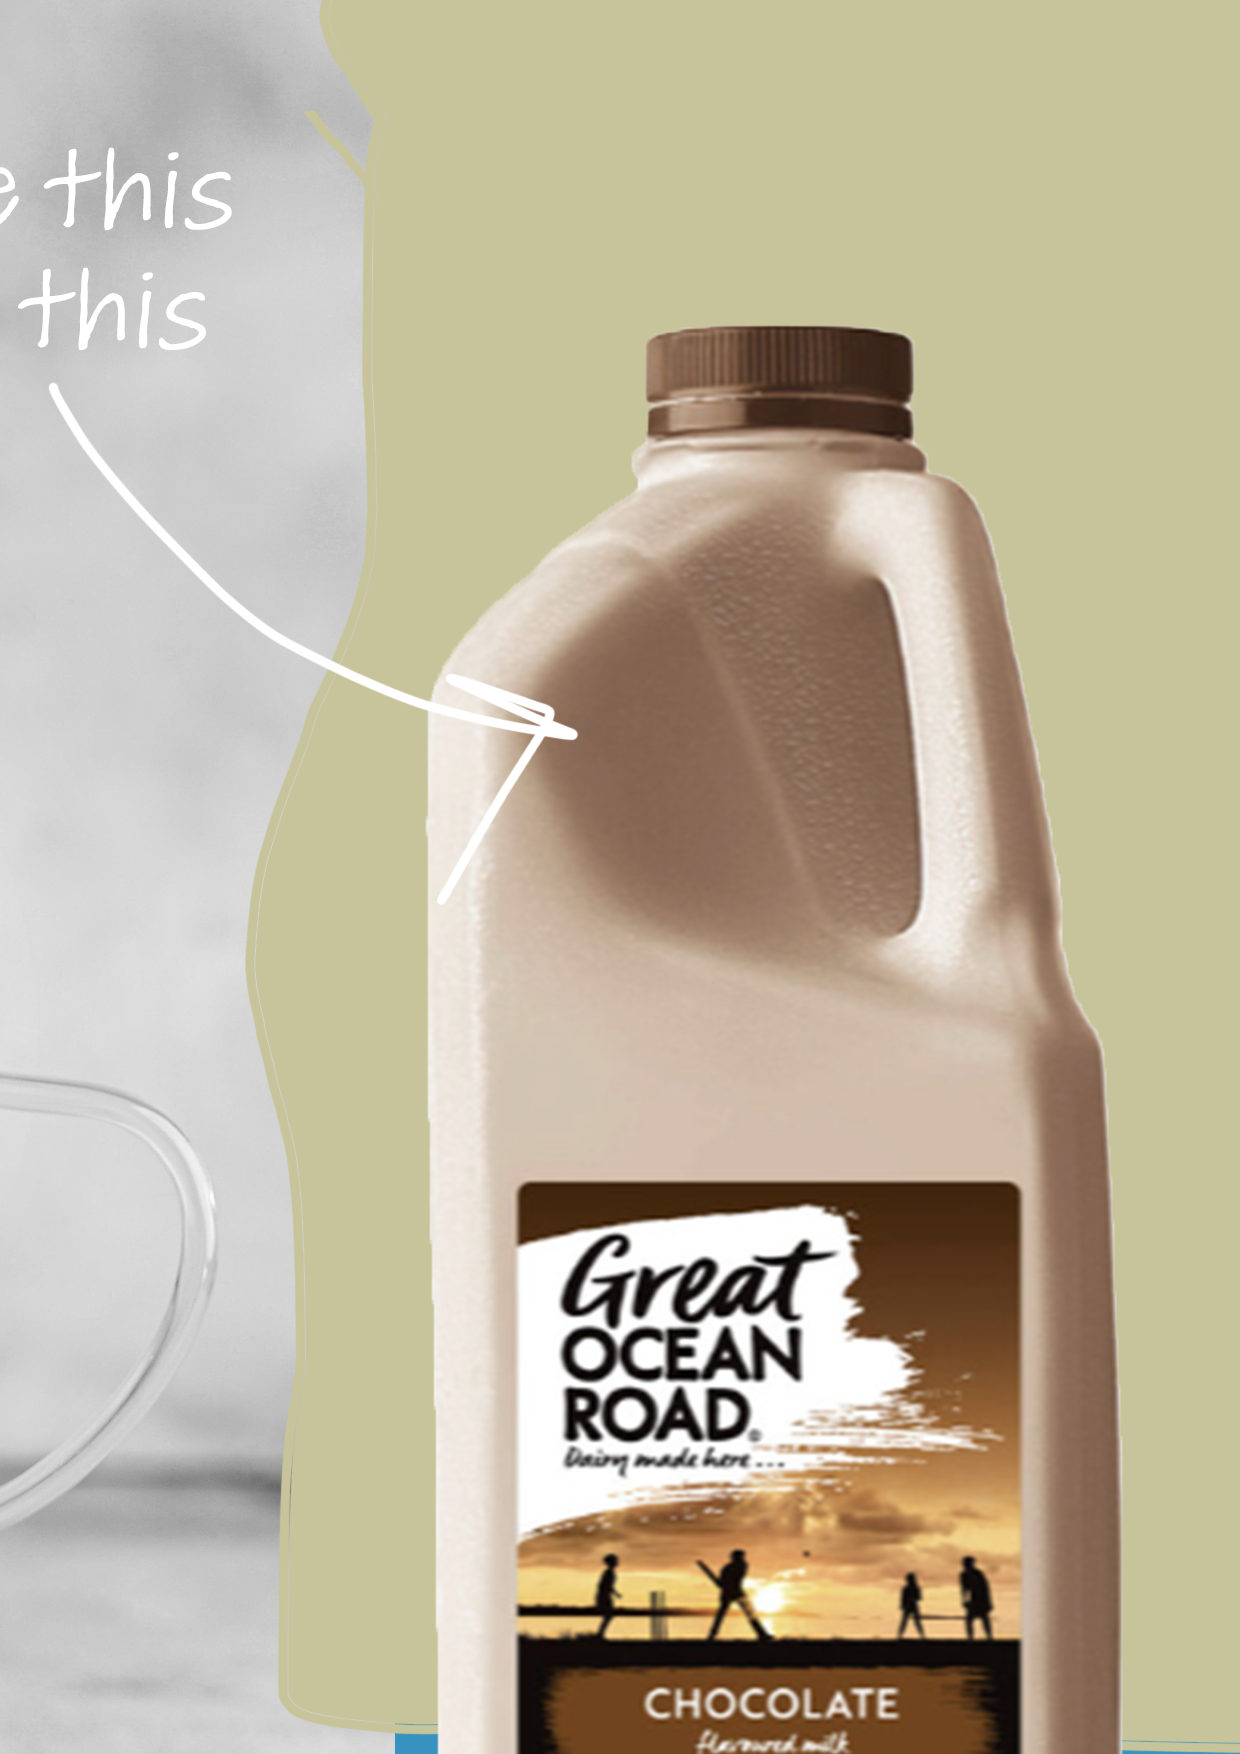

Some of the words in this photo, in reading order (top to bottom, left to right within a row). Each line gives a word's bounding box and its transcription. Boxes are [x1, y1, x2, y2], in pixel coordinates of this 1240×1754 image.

[43, 147, 233, 231] this
[17, 267, 207, 351] this
[560, 1233, 839, 1329] Great
[561, 1325, 803, 1383] OCEAN
[564, 1446, 629, 1478] Dairy
[633, 1447, 698, 1469] made
[643, 1686, 901, 1721] CHOCOLATE
[800, 1731, 852, 1754] milk
